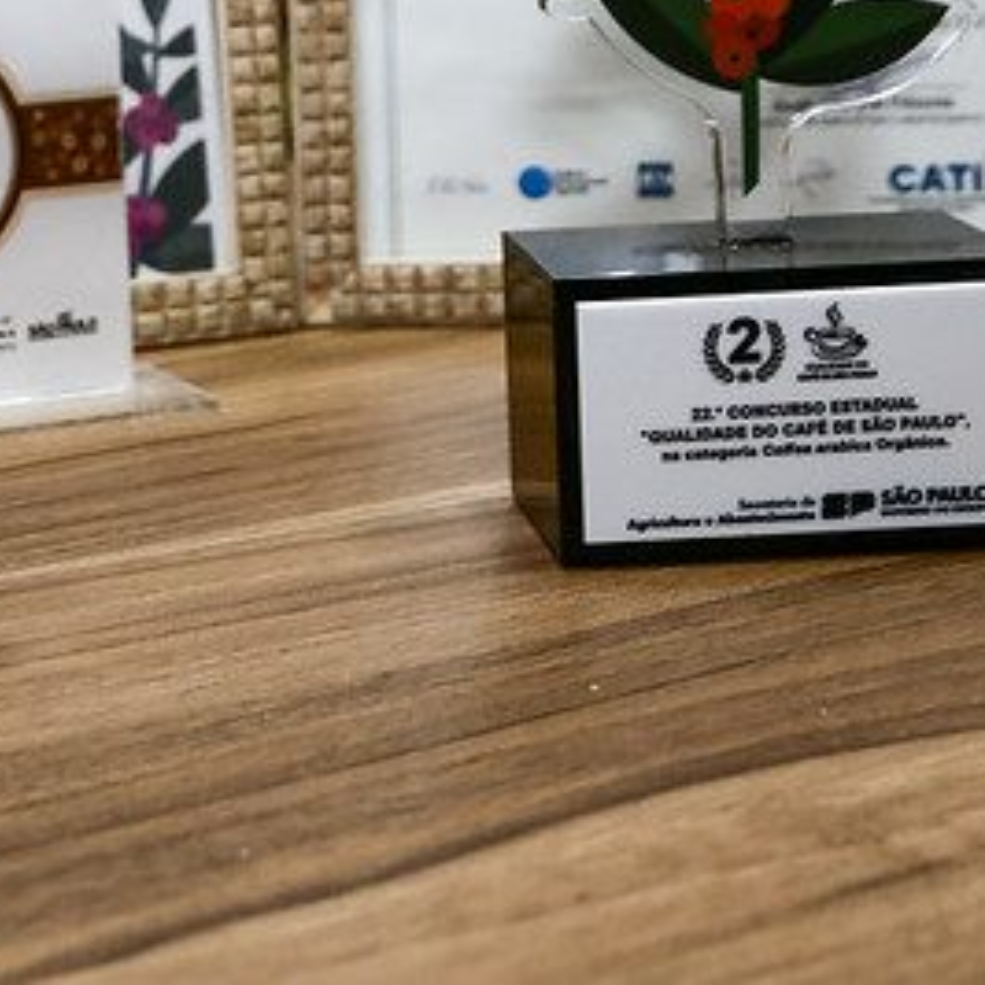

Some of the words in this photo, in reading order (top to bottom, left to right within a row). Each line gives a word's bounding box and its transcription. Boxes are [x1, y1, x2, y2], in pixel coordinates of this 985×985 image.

[888, 163, 983, 194] CATI
[725, 316, 762, 364] 2
[726, 401, 826, 419] CONCURSO
[829, 396, 919, 416] ESTADUAL
[751, 422, 778, 439] DO
[781, 417, 827, 437] CAFÉ
[832, 418, 856, 435] DE
[861, 415, 896, 433] SÃO
[684, 446, 758, 463] categoria
[814, 438, 872, 455] arabica
[881, 484, 921, 506] SÃO
